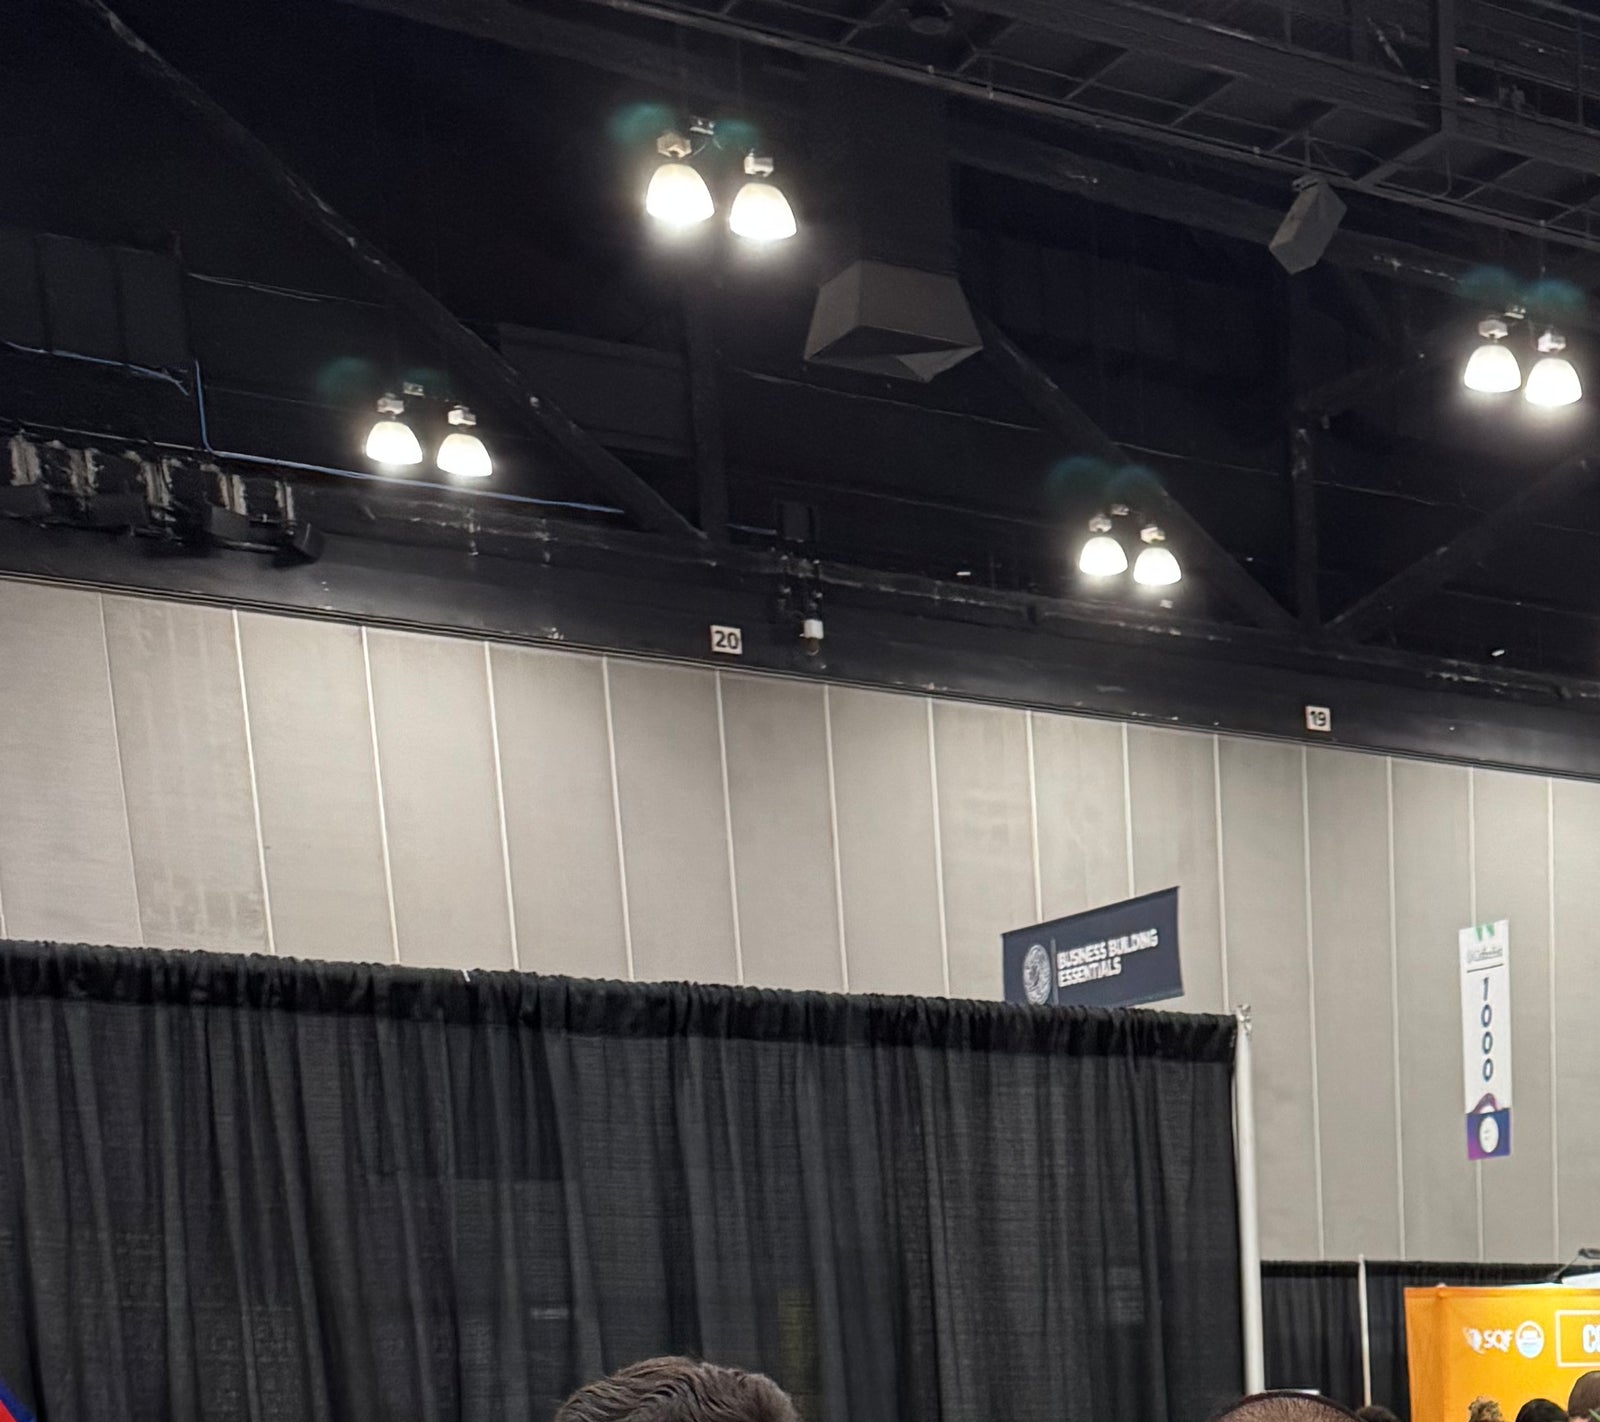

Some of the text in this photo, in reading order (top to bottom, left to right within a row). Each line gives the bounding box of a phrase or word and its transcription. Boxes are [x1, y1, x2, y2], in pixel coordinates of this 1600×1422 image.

[714, 630, 739, 650] 20
[1310, 710, 1327, 727] 19
[1057, 928, 1159, 970] BUSINESS BUILDING
[1058, 957, 1122, 988] ESSENTIALS
